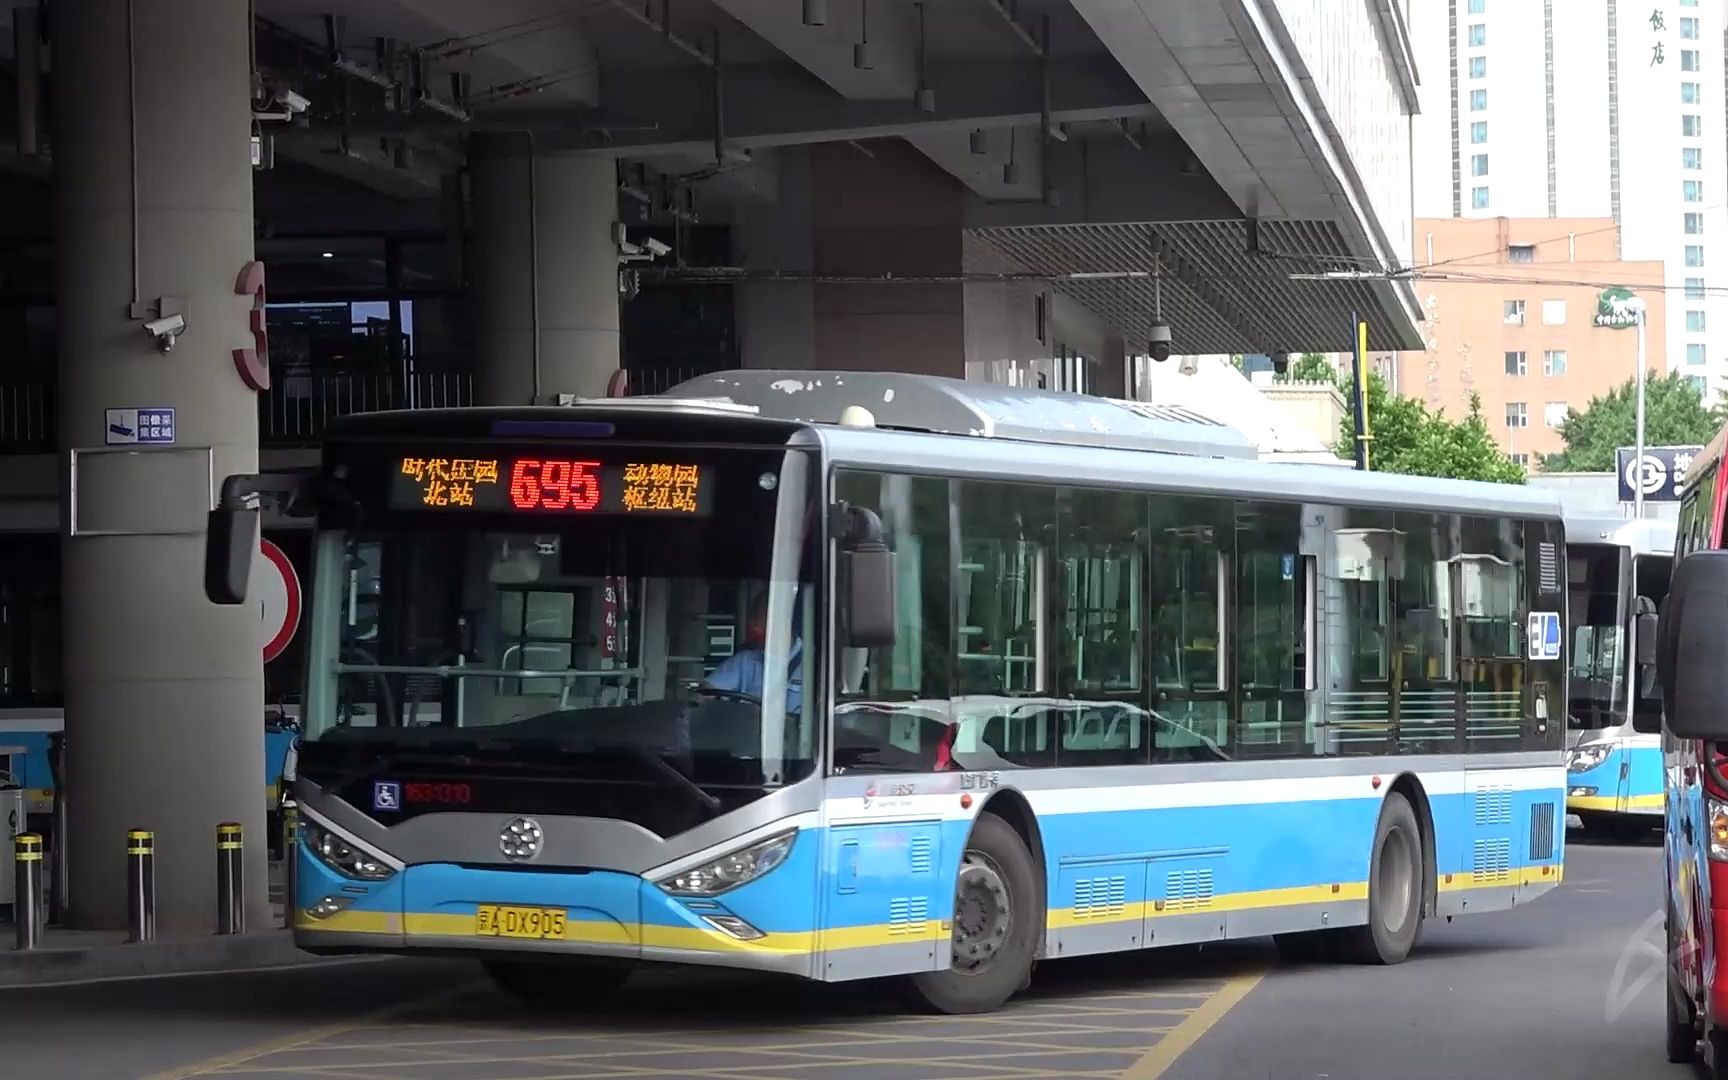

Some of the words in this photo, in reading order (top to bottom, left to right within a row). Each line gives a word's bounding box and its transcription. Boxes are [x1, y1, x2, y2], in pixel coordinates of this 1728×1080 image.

[231, 260, 271, 391] 3
[510, 459, 601, 510] 695
[622, 463, 698, 488] 动物园
[422, 481, 475, 506] 北站
[621, 486, 698, 512] 枢纽站
